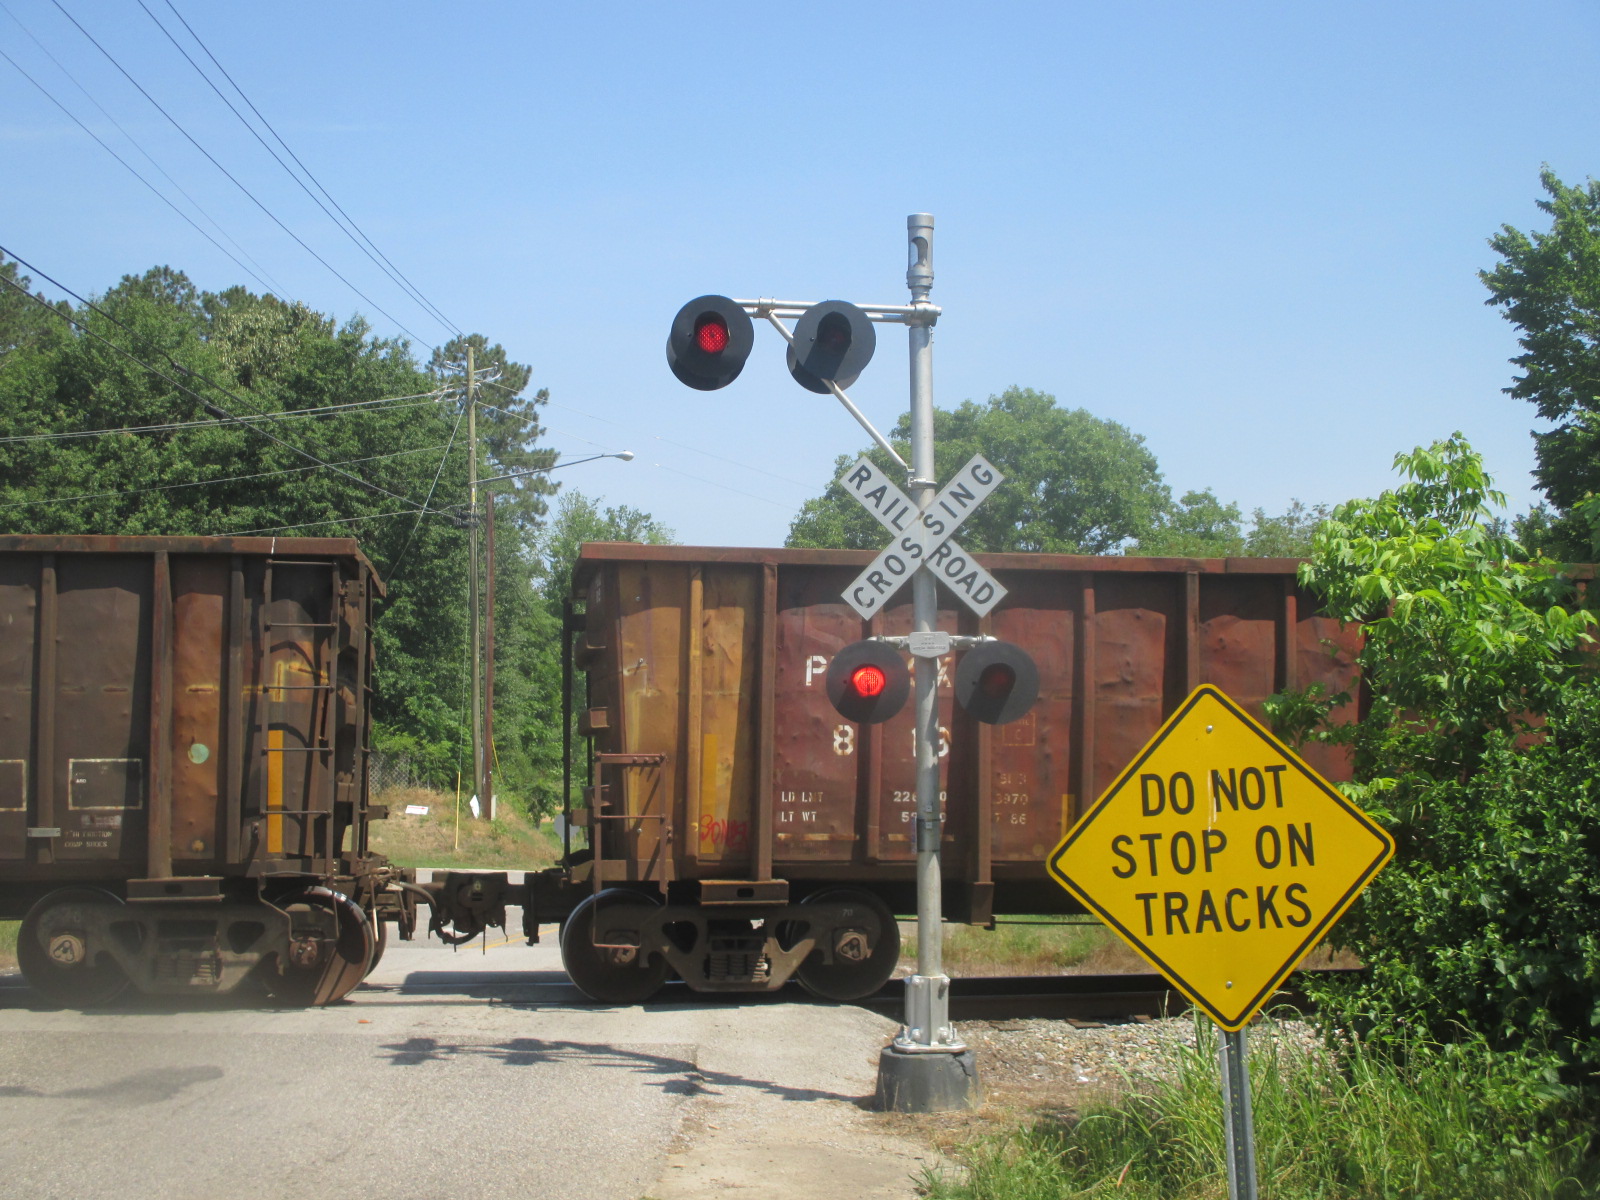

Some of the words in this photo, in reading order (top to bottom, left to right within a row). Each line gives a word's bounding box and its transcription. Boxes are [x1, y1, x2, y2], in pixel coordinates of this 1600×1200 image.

[848, 464, 910, 532] RAIL
[928, 541, 995, 605] ROAD
[781, 810, 795, 823] LT
[801, 810, 817, 823] WT
[1140, 771, 1195, 817] DO
[1210, 765, 1287, 813] NOT
[1111, 829, 1227, 879] STOP
[1255, 822, 1315, 869] ON
[1135, 883, 1313, 936] TRACKS
